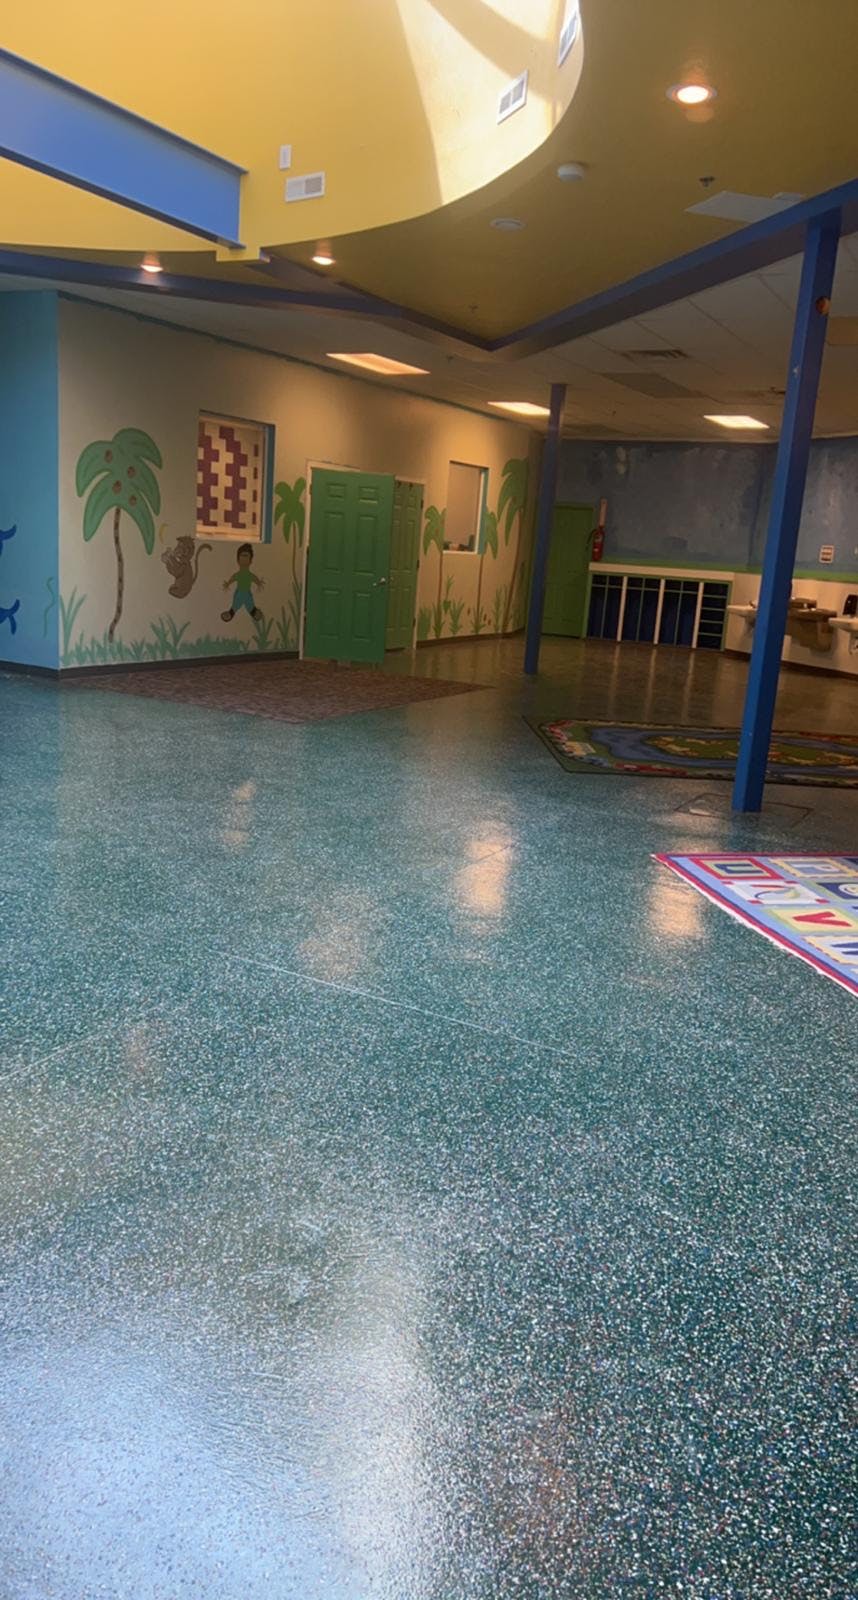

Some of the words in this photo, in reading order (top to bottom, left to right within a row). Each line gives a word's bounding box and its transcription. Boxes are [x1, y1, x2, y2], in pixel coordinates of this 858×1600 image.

[714, 863, 764, 874] U
[790, 864, 839, 872] P
[792, 911, 852, 927] V
